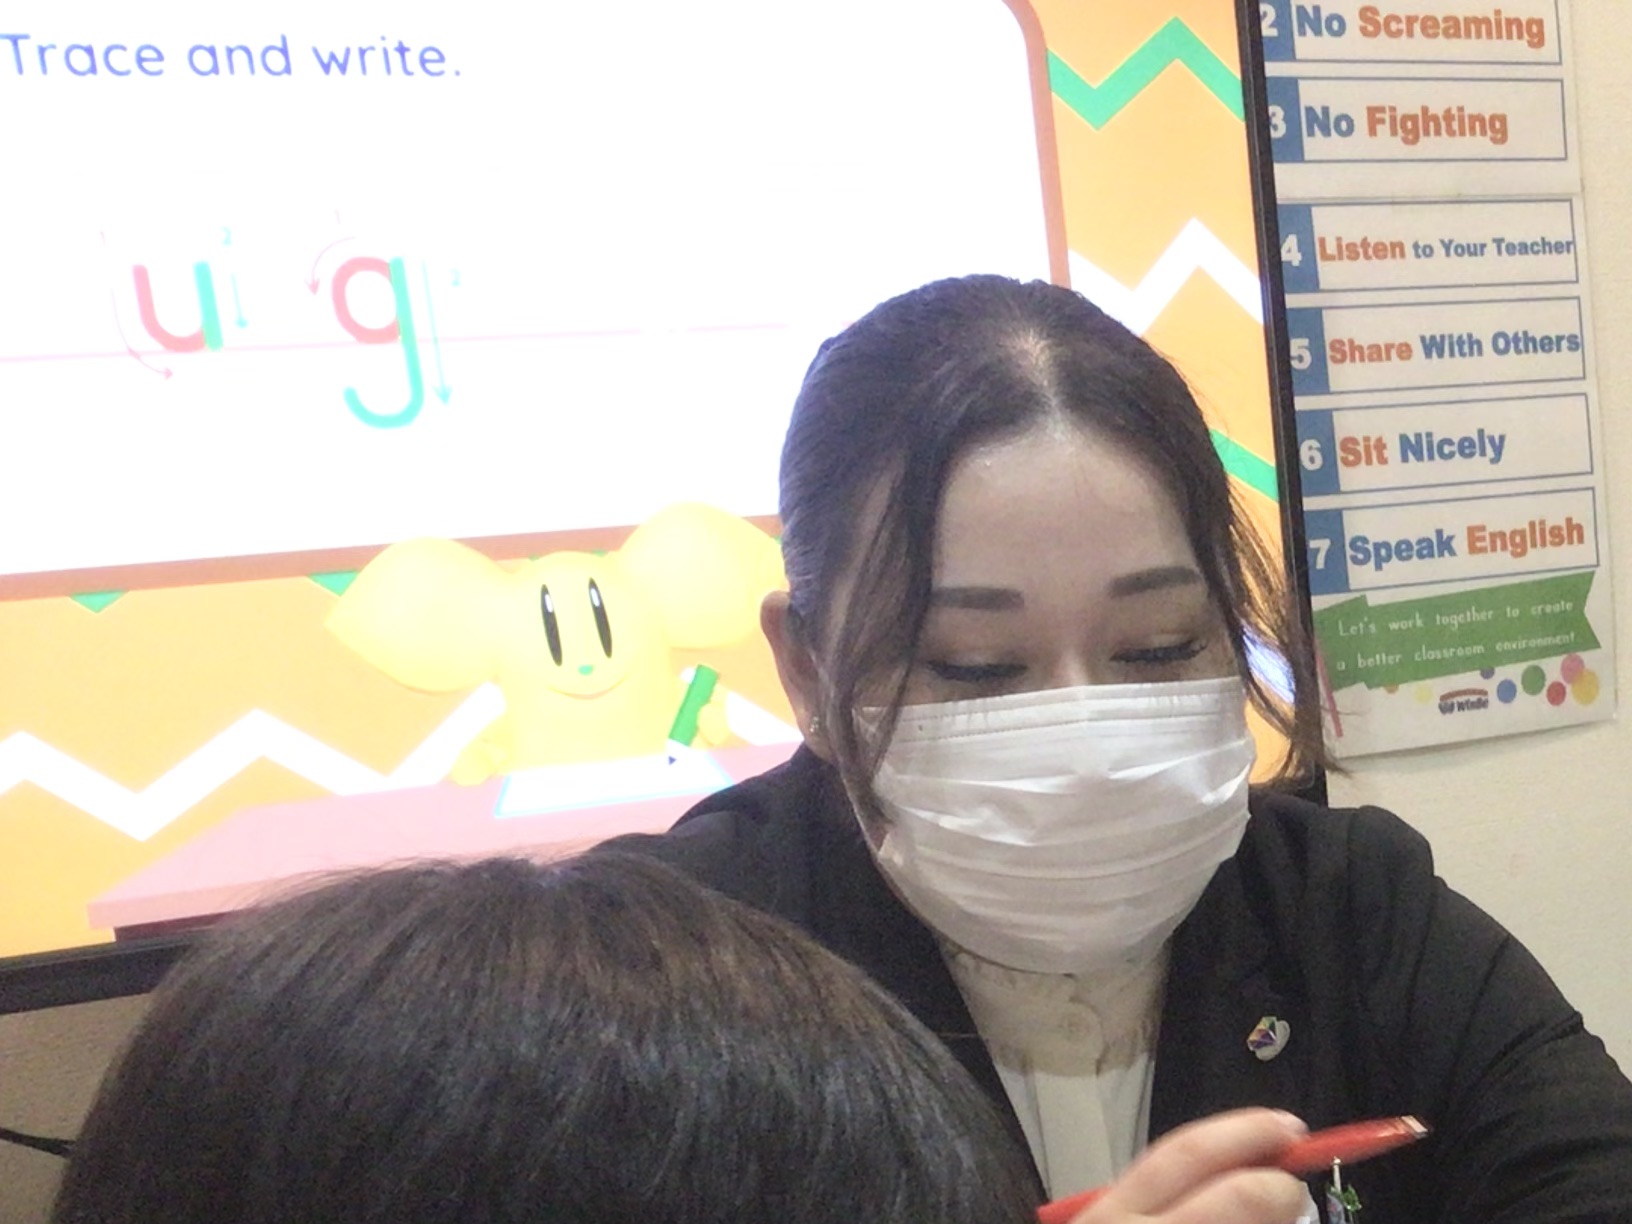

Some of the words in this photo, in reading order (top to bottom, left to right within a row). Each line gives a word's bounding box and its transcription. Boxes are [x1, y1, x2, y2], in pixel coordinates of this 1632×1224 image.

[1260, 2, 1279, 37] 2
[1296, 5, 1347, 38] No
[1358, 5, 1546, 49] Screaming
[0, 33, 165, 77] Trace
[187, 35, 293, 77] and
[311, 36, 462, 77] write.
[1268, 105, 1288, 139] 3
[1305, 106, 1356, 138] No
[1366, 105, 1509, 145] Fighting
[1281, 233, 1302, 267] 4
[1318, 236, 1406, 262] Listen
[1412, 240, 1435, 259] to
[1439, 238, 1487, 258] Your
[1493, 237, 1575, 257] Teacher
[1289, 338, 1312, 370] 5
[1329, 338, 1413, 364] Share
[1420, 331, 1483, 360] With
[1491, 330, 1582, 357] Others
[1300, 439, 1323, 471] 6
[1339, 435, 1389, 468] Sit
[1399, 428, 1507, 464] Nicely
[1309, 538, 1332, 570] 7
[1349, 529, 1458, 572] Speak
[1466, 517, 1585, 558] English
[1338, 616, 1376, 637] Let's
[1388, 613, 1424, 632] work
[1435, 606, 1494, 631] together
[1506, 606, 1520, 619] to
[1530, 600, 1574, 615] create
[1336, 659, 1346, 671] a
[1357, 652, 1402, 669] better
[1414, 645, 1485, 662] classroom
[1495, 632, 1576, 653] environment
